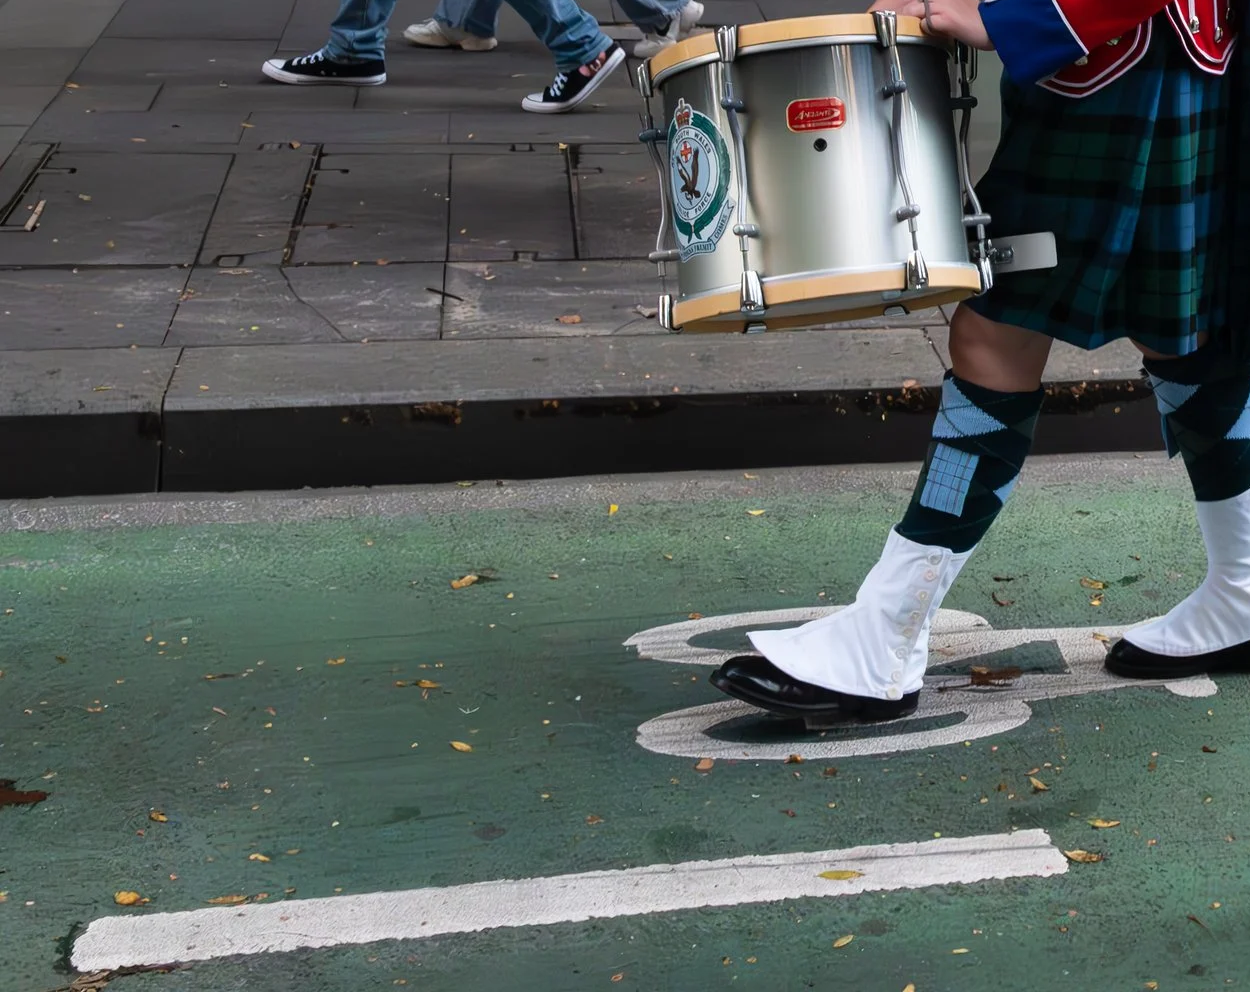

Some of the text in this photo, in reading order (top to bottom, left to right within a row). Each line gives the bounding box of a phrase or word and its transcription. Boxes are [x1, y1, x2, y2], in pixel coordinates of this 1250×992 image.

[675, 129, 711, 155] SOUTH WALES
[694, 191, 712, 215] FORCE
